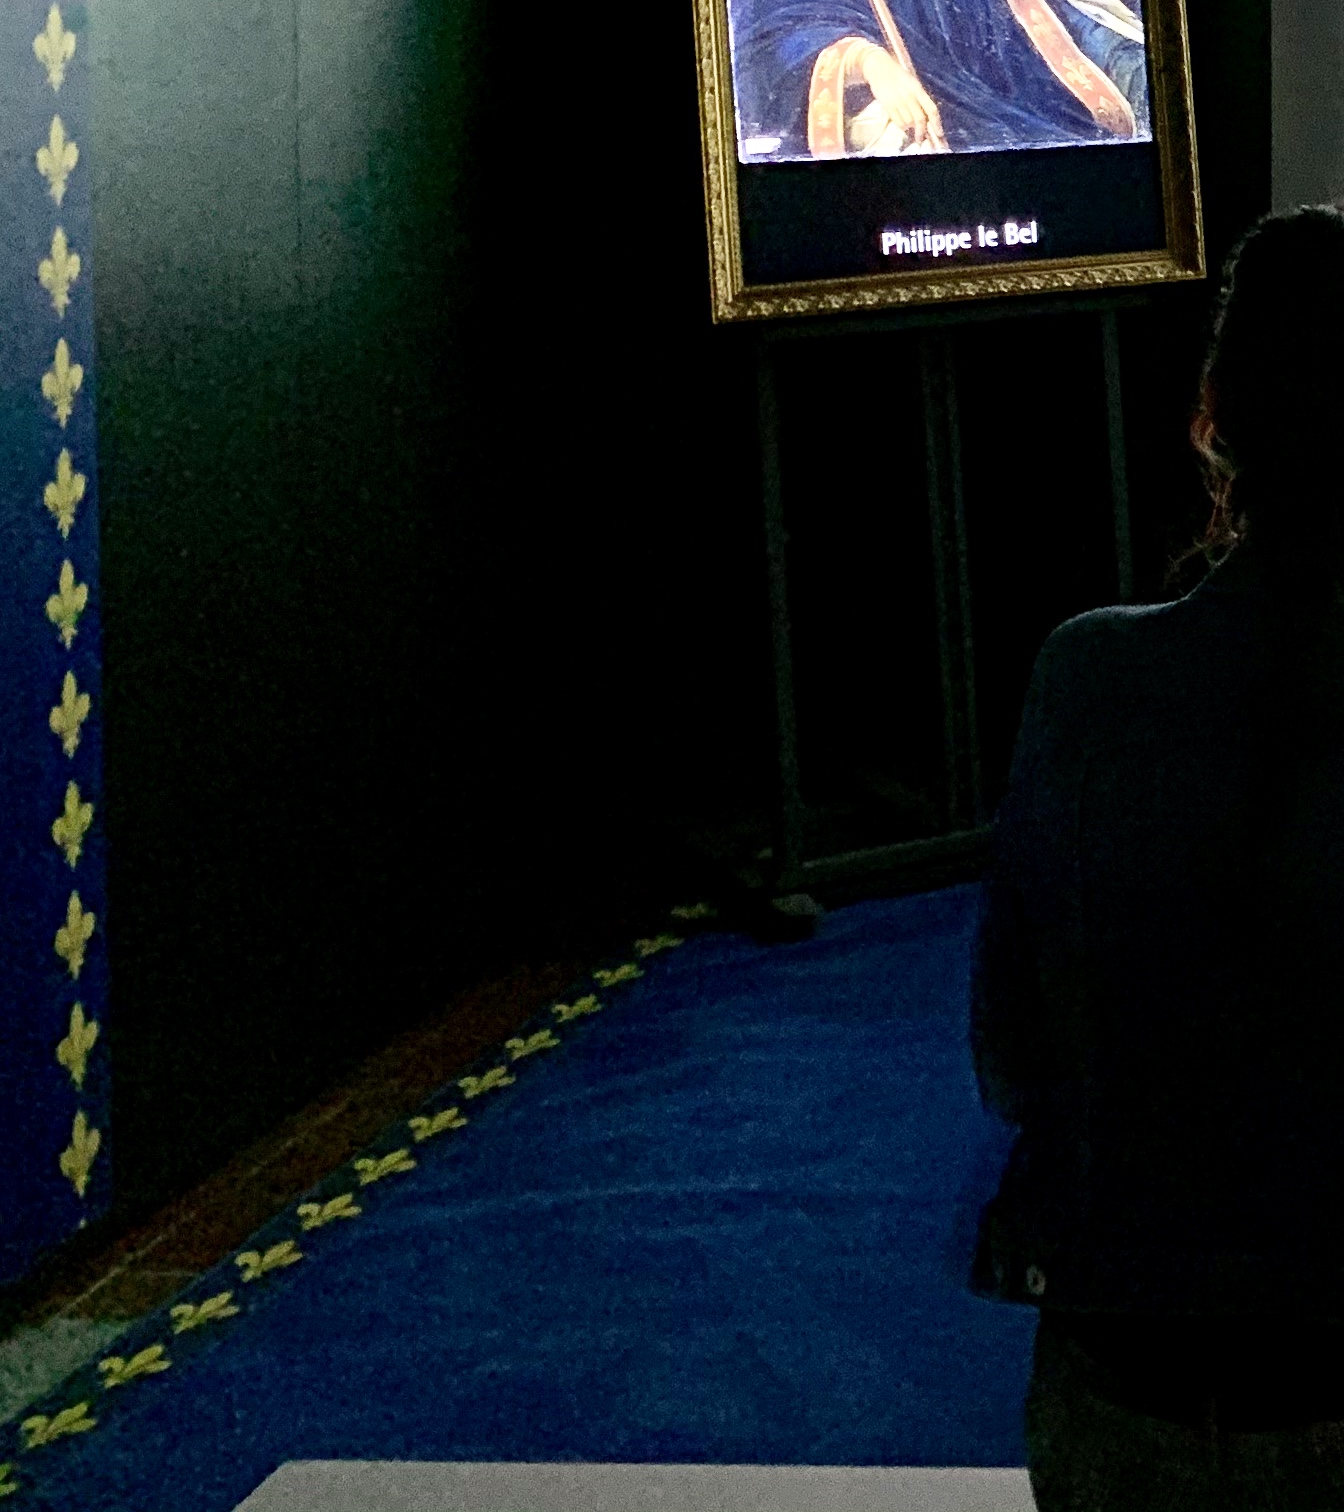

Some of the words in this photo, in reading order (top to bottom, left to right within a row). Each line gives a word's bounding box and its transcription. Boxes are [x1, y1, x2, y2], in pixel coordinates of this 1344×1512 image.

[882, 230, 971, 256] Philippe
[978, 225, 998, 247] le
[1004, 221, 1037, 245] Bel
